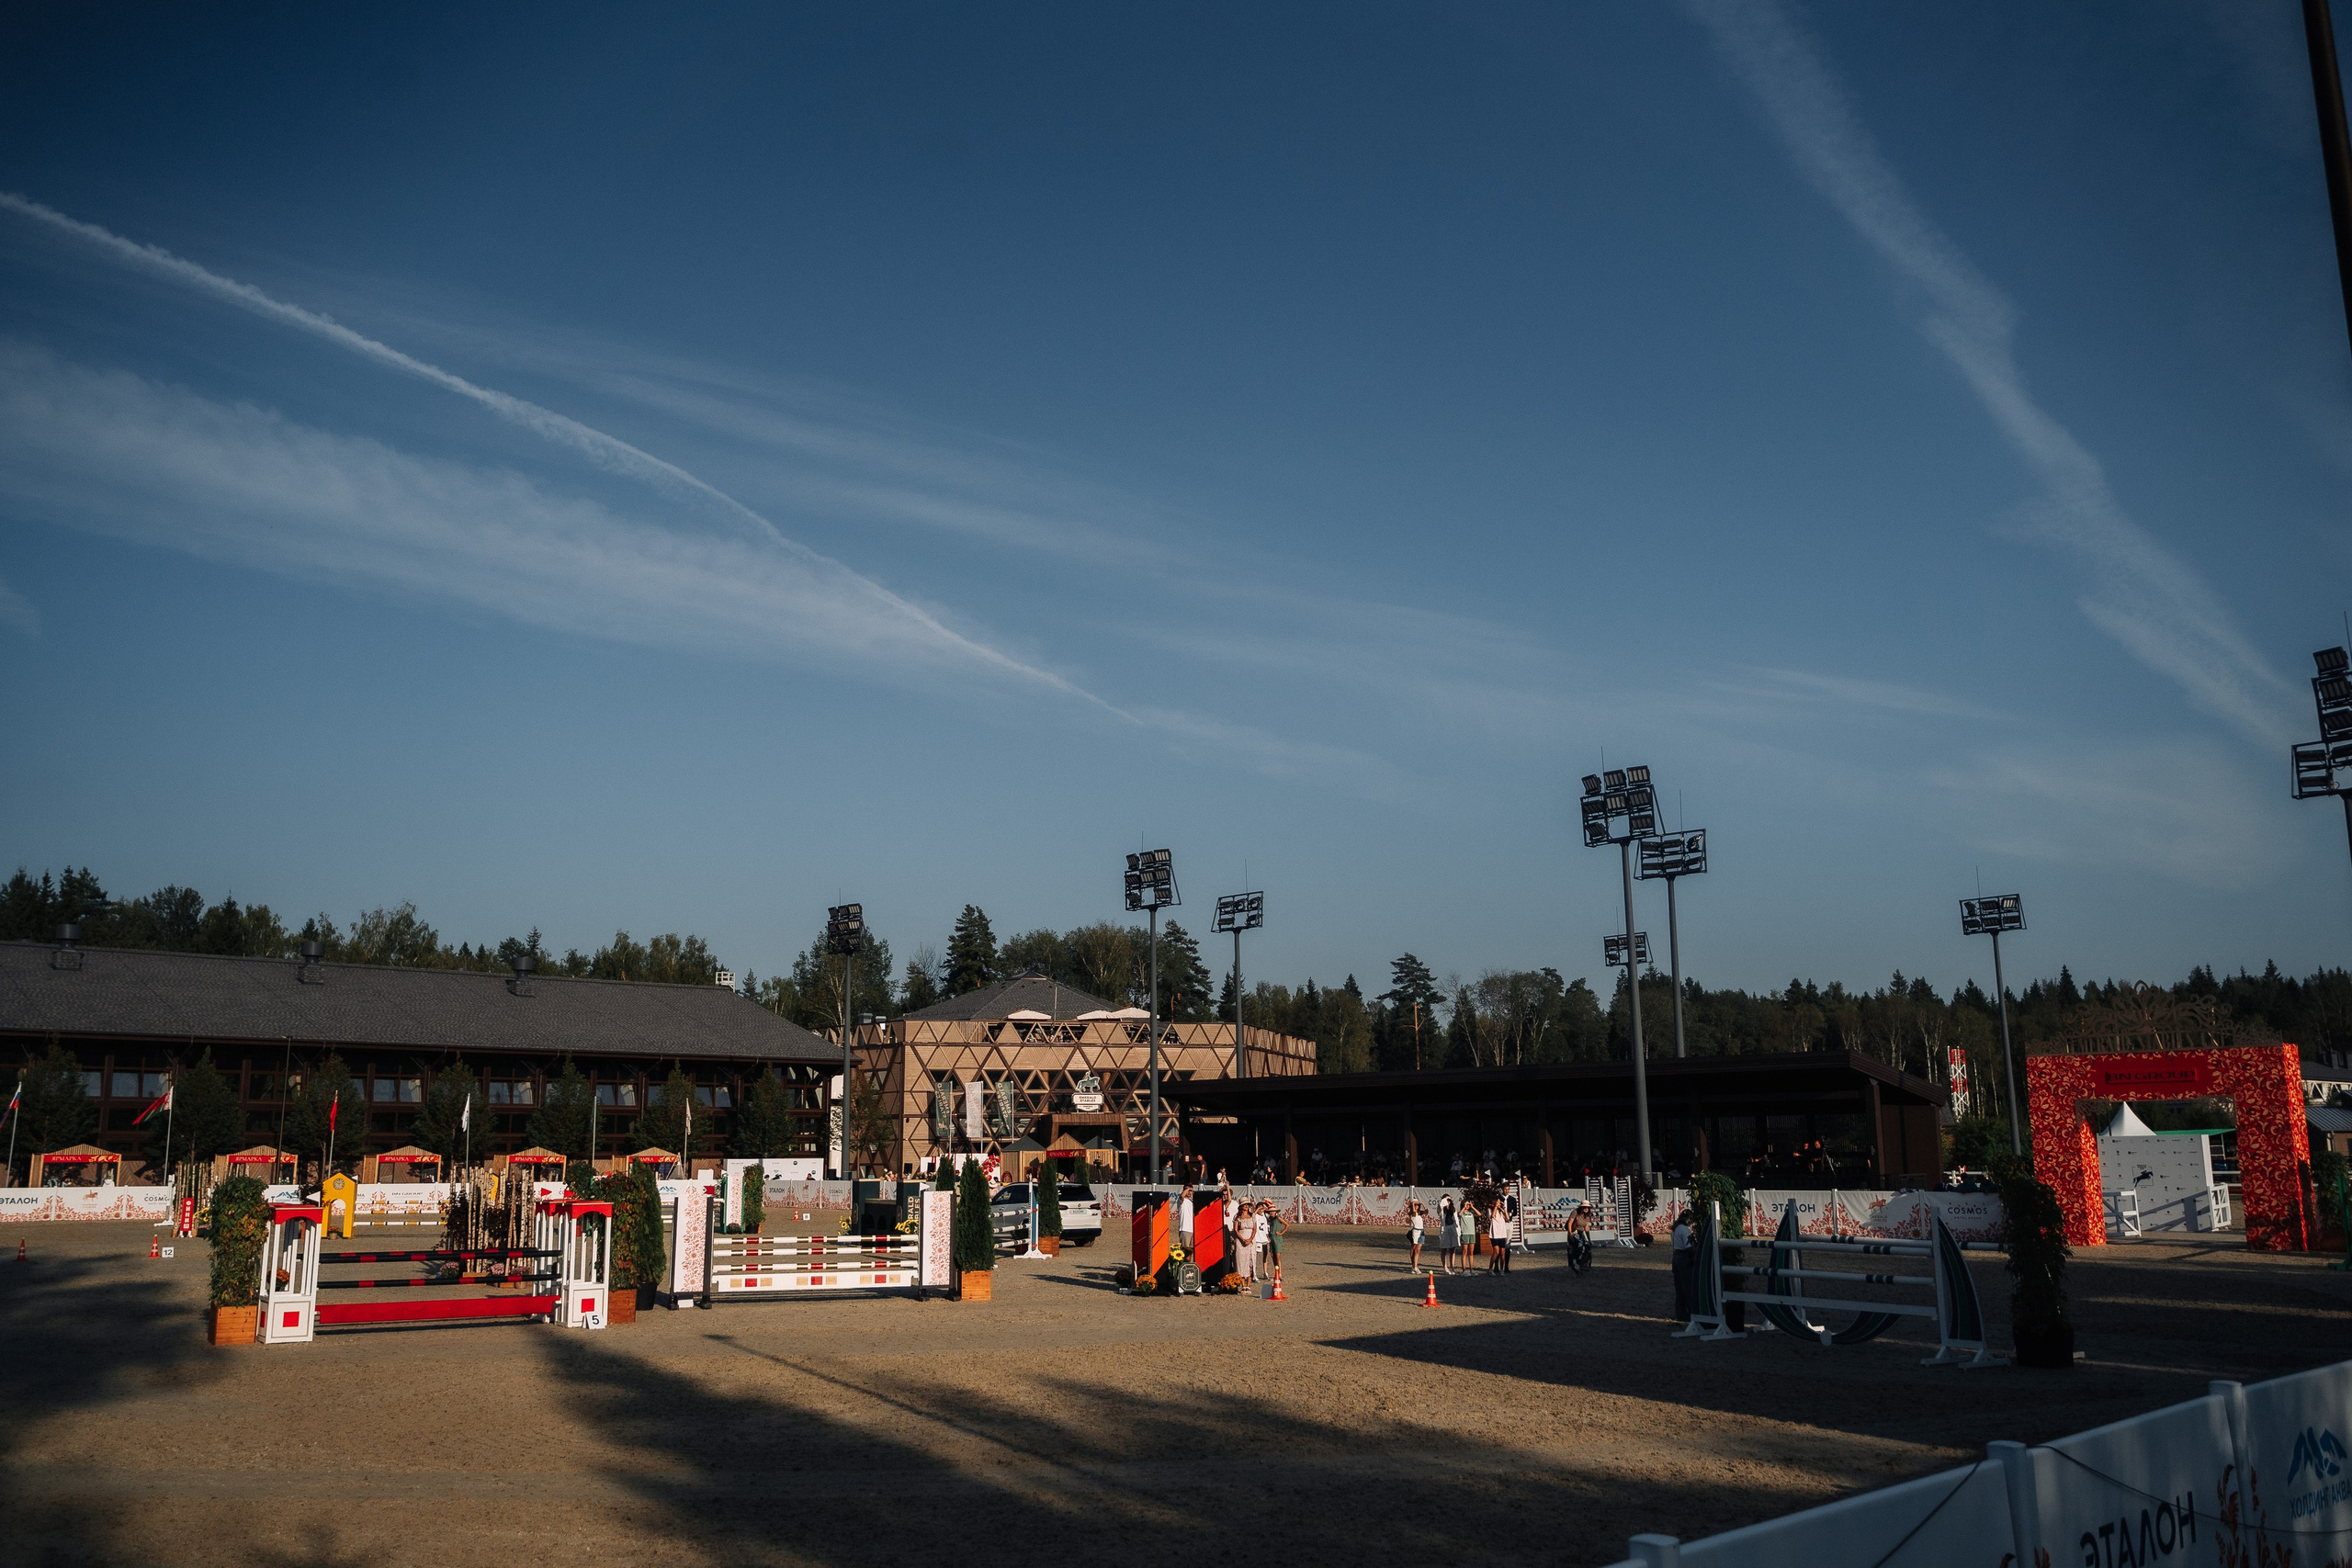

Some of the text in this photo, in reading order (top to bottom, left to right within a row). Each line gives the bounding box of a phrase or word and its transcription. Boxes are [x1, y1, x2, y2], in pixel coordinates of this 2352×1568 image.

[2134, 1070, 2196, 1080] GROUP
[1947, 1207, 1988, 1215] COSMOS
[592, 1314, 600, 1325] 5
[2290, 1486, 2329, 1520] ХОЛДИНГ
[2080, 1491, 2197, 1568] ЭТАЛОН
